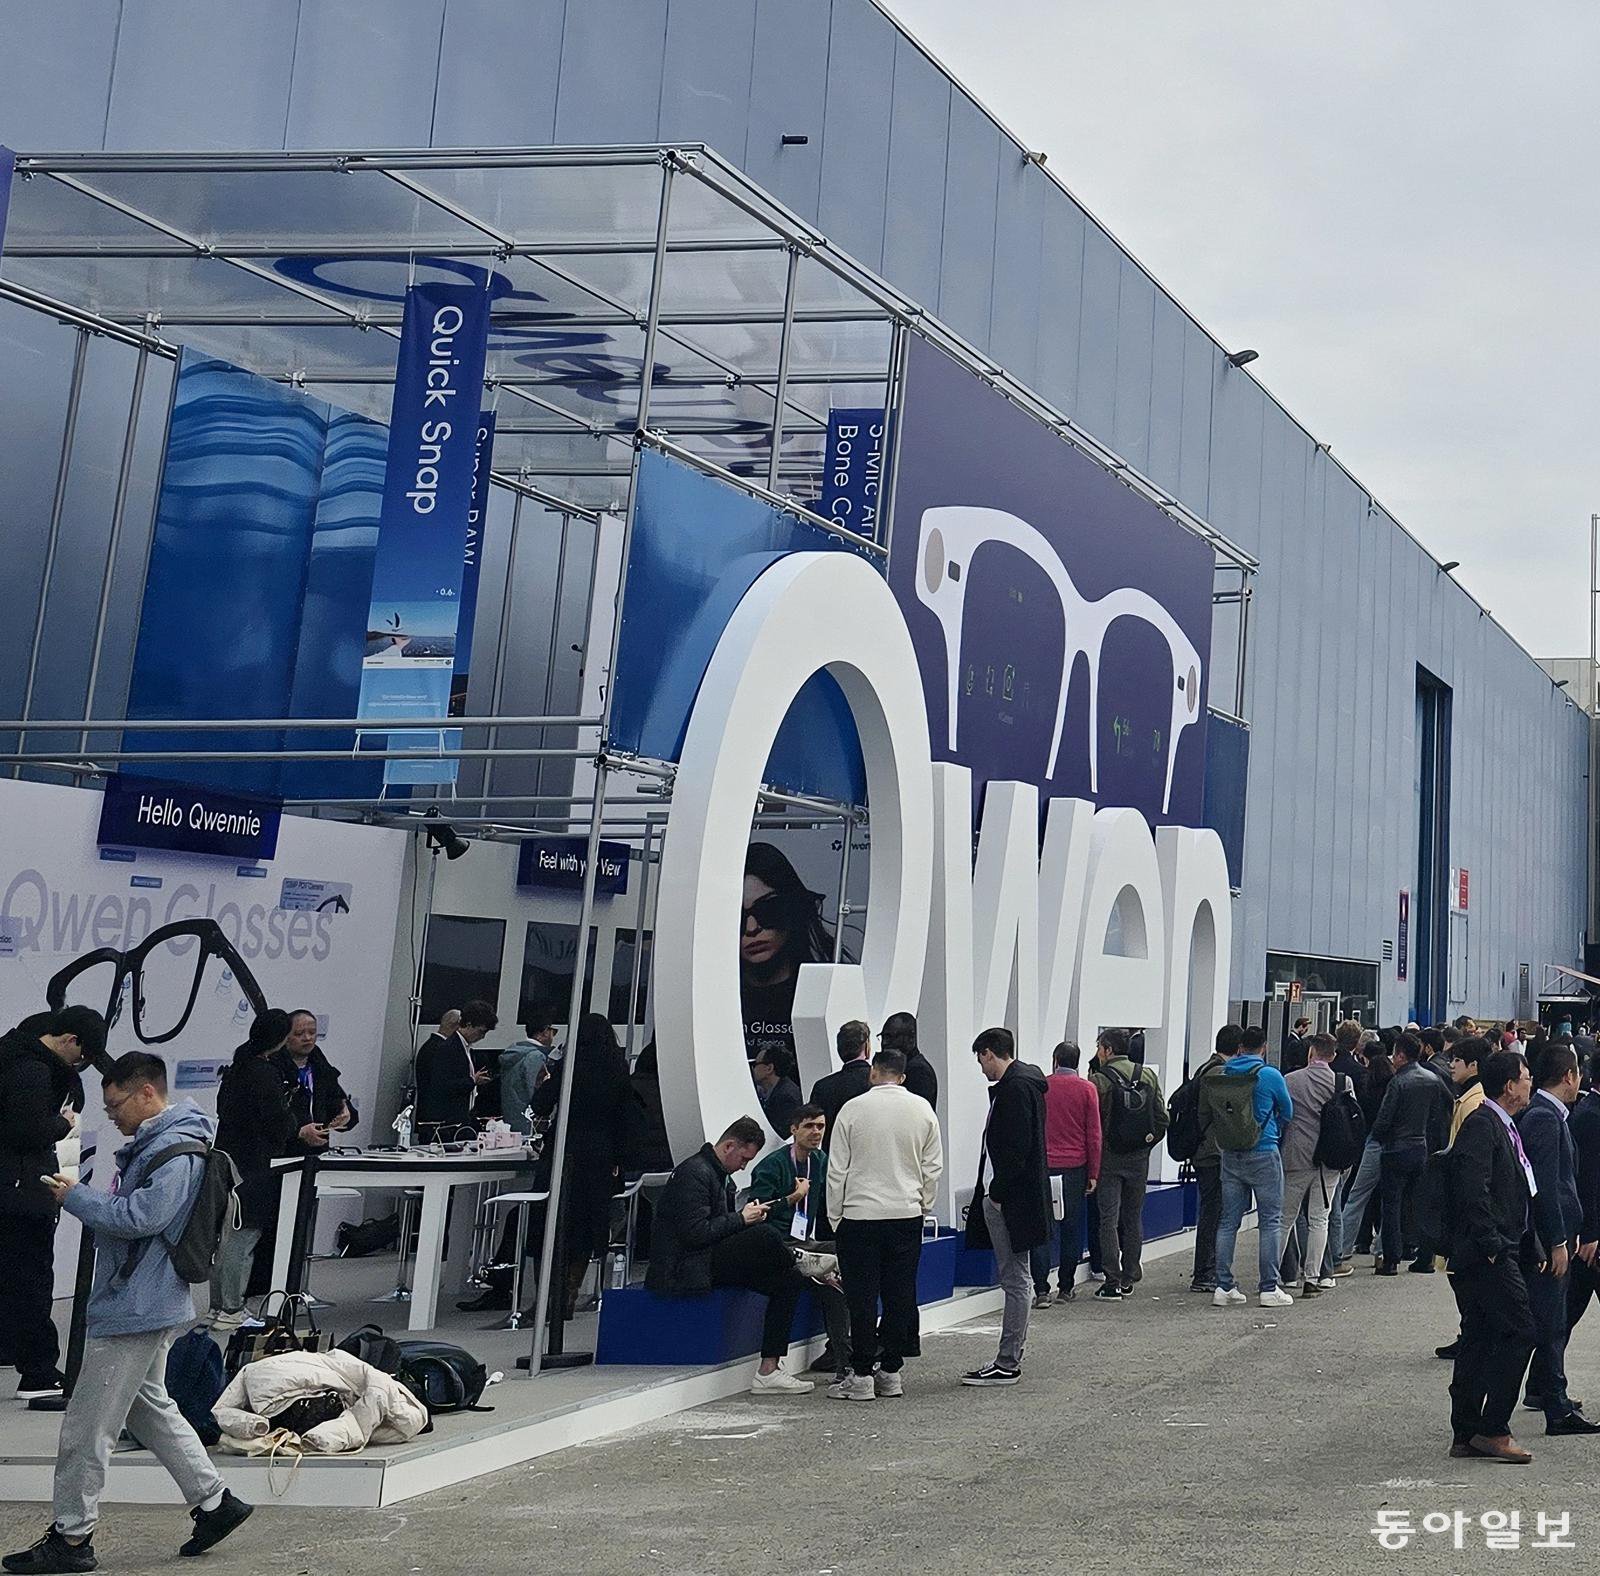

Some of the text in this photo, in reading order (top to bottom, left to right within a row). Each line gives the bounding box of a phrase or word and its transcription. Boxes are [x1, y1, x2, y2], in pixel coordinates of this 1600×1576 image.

[406, 305, 463, 514] Quick Snap
[834, 425, 858, 487] Bone
[138, 795, 261, 836] Hello Qwennie
[539, 850, 558, 870] Feel
[560, 853, 578, 872] with
[600, 858, 621, 876] View
[654, 550, 1231, 1228] Qwen
[2, 869, 152, 952] Qwen
